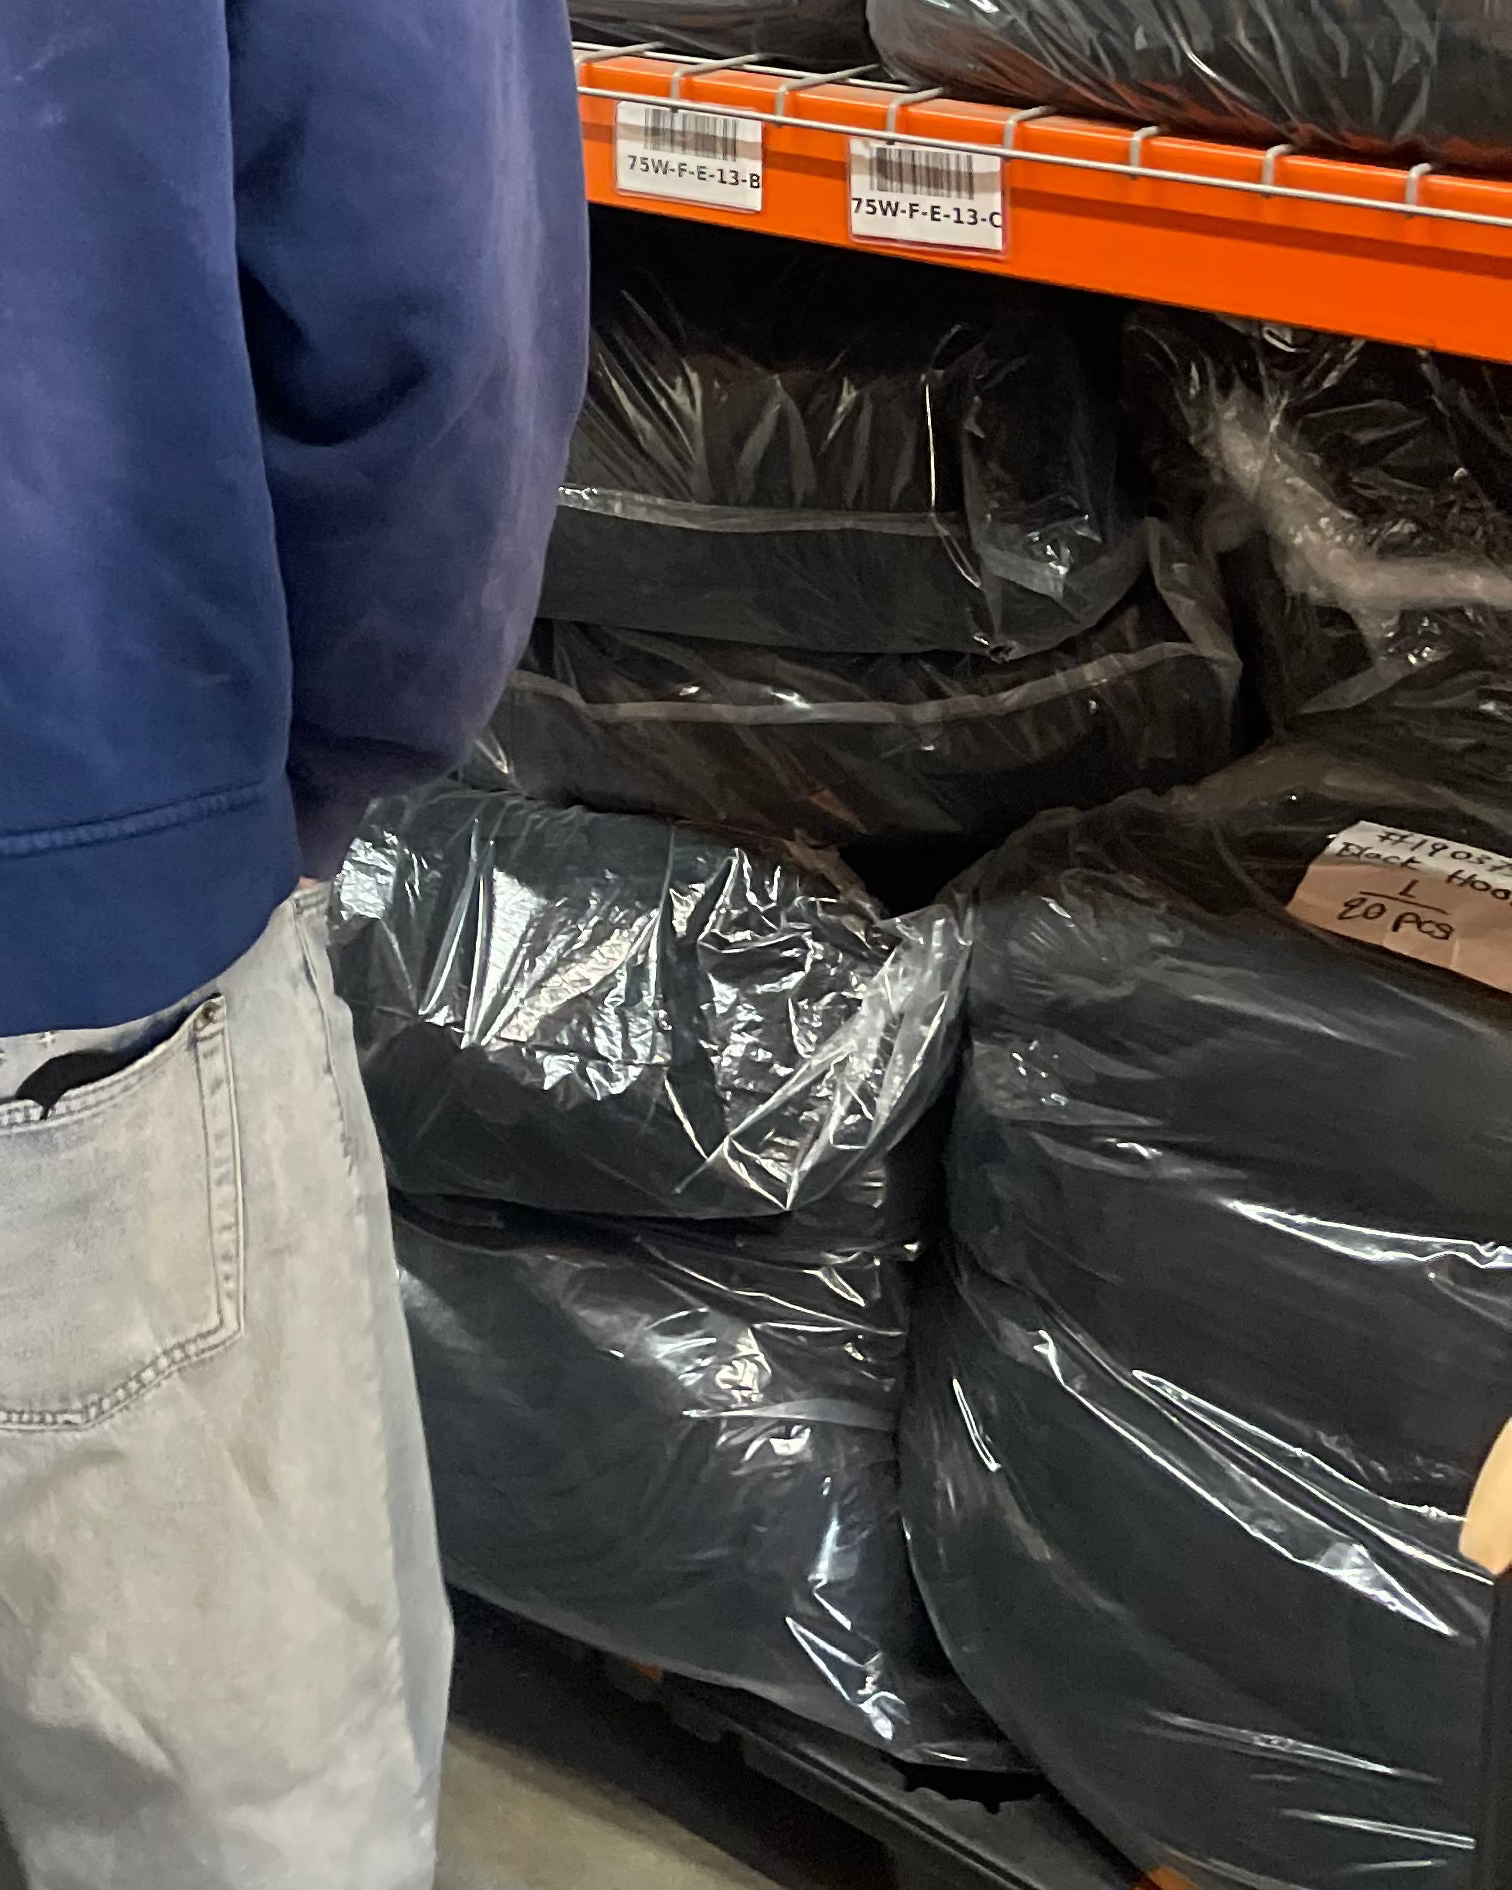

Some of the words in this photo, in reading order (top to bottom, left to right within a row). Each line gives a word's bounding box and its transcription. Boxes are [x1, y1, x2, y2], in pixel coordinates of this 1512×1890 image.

[627, 154, 761, 189] 75W-F-E-13-B
[851, 197, 1003, 229] 75W-F-E-13-C
[1335, 841, 1423, 871] Black
[1445, 869, 1512, 907] Hoo
[1398, 879, 1420, 898] L
